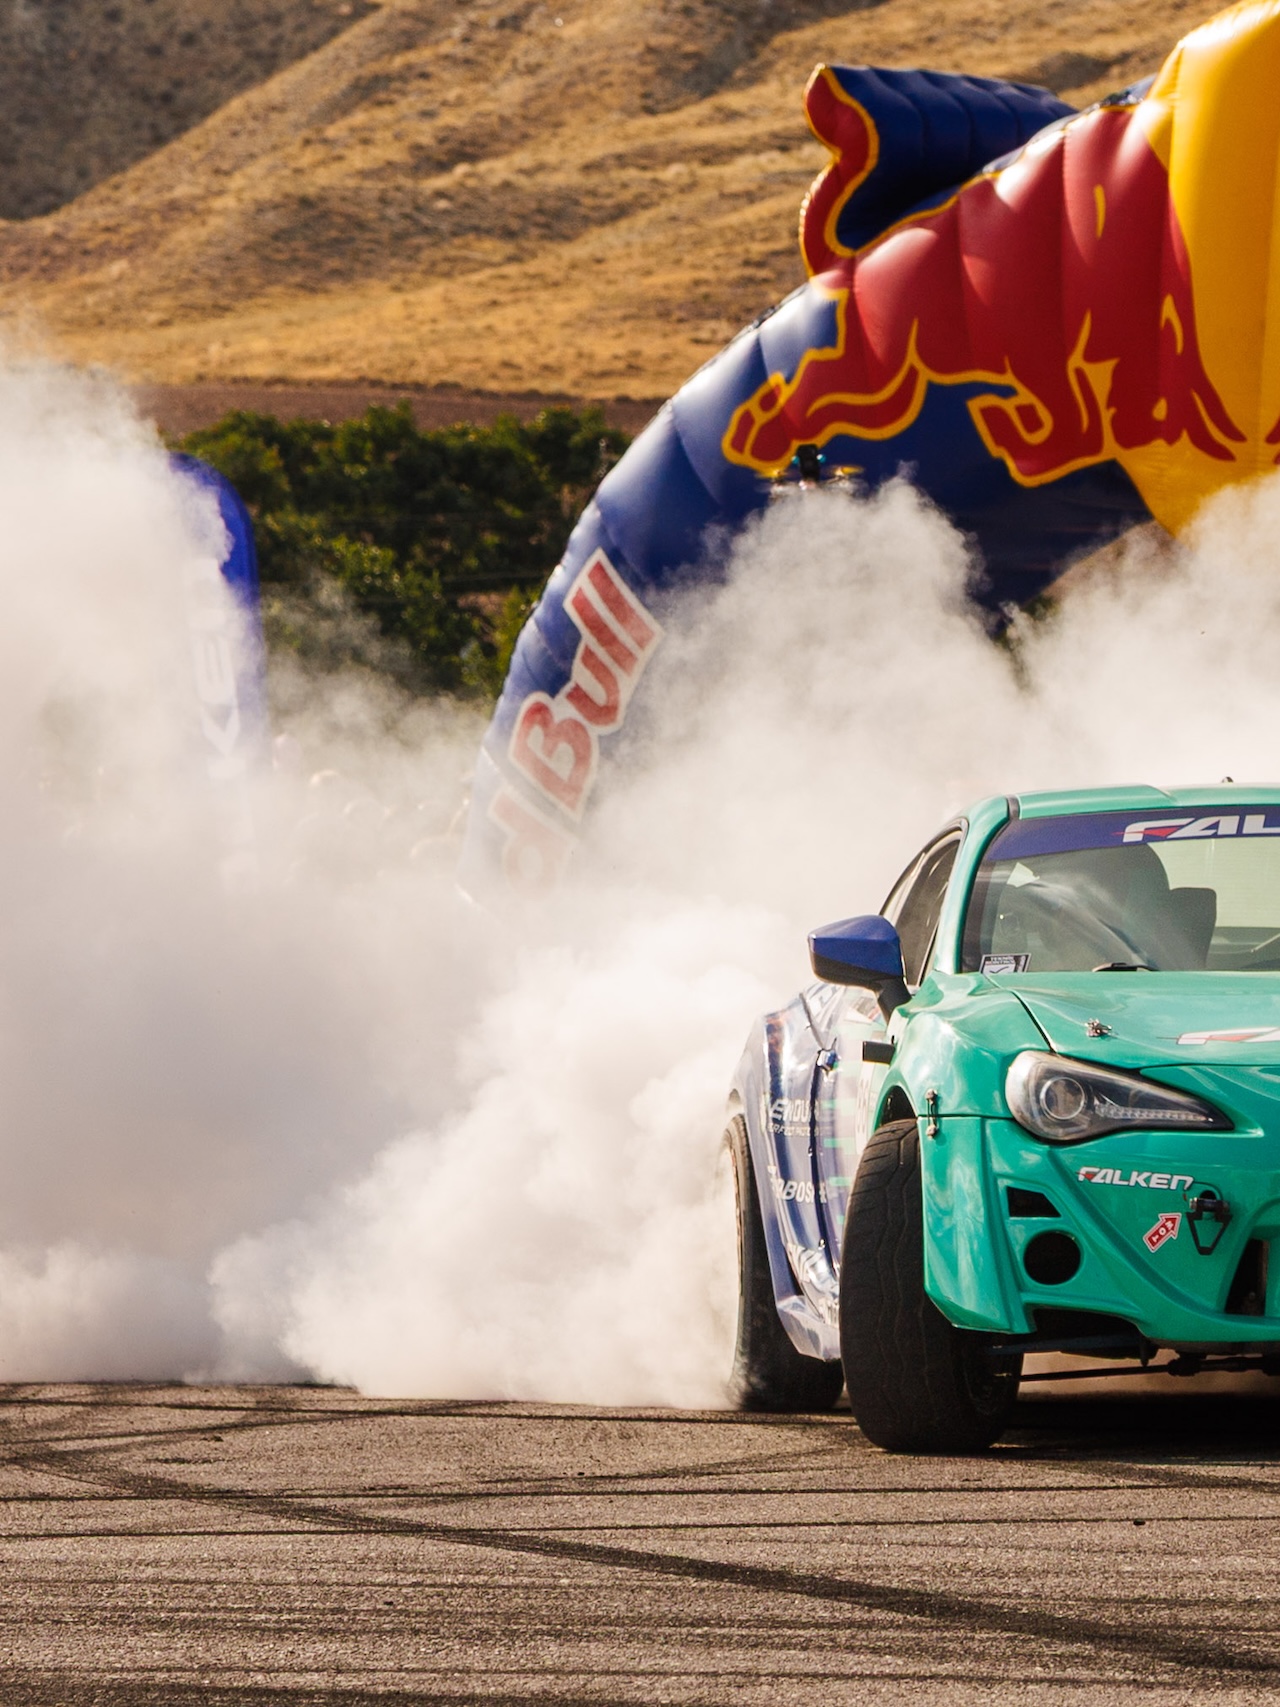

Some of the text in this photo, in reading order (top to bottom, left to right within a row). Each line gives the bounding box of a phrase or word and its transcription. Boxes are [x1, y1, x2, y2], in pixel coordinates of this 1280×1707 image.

[508, 549, 663, 821] Bull
[1078, 1166, 1194, 1190] FALKEN
[1151, 1220, 1174, 1243] TOW
